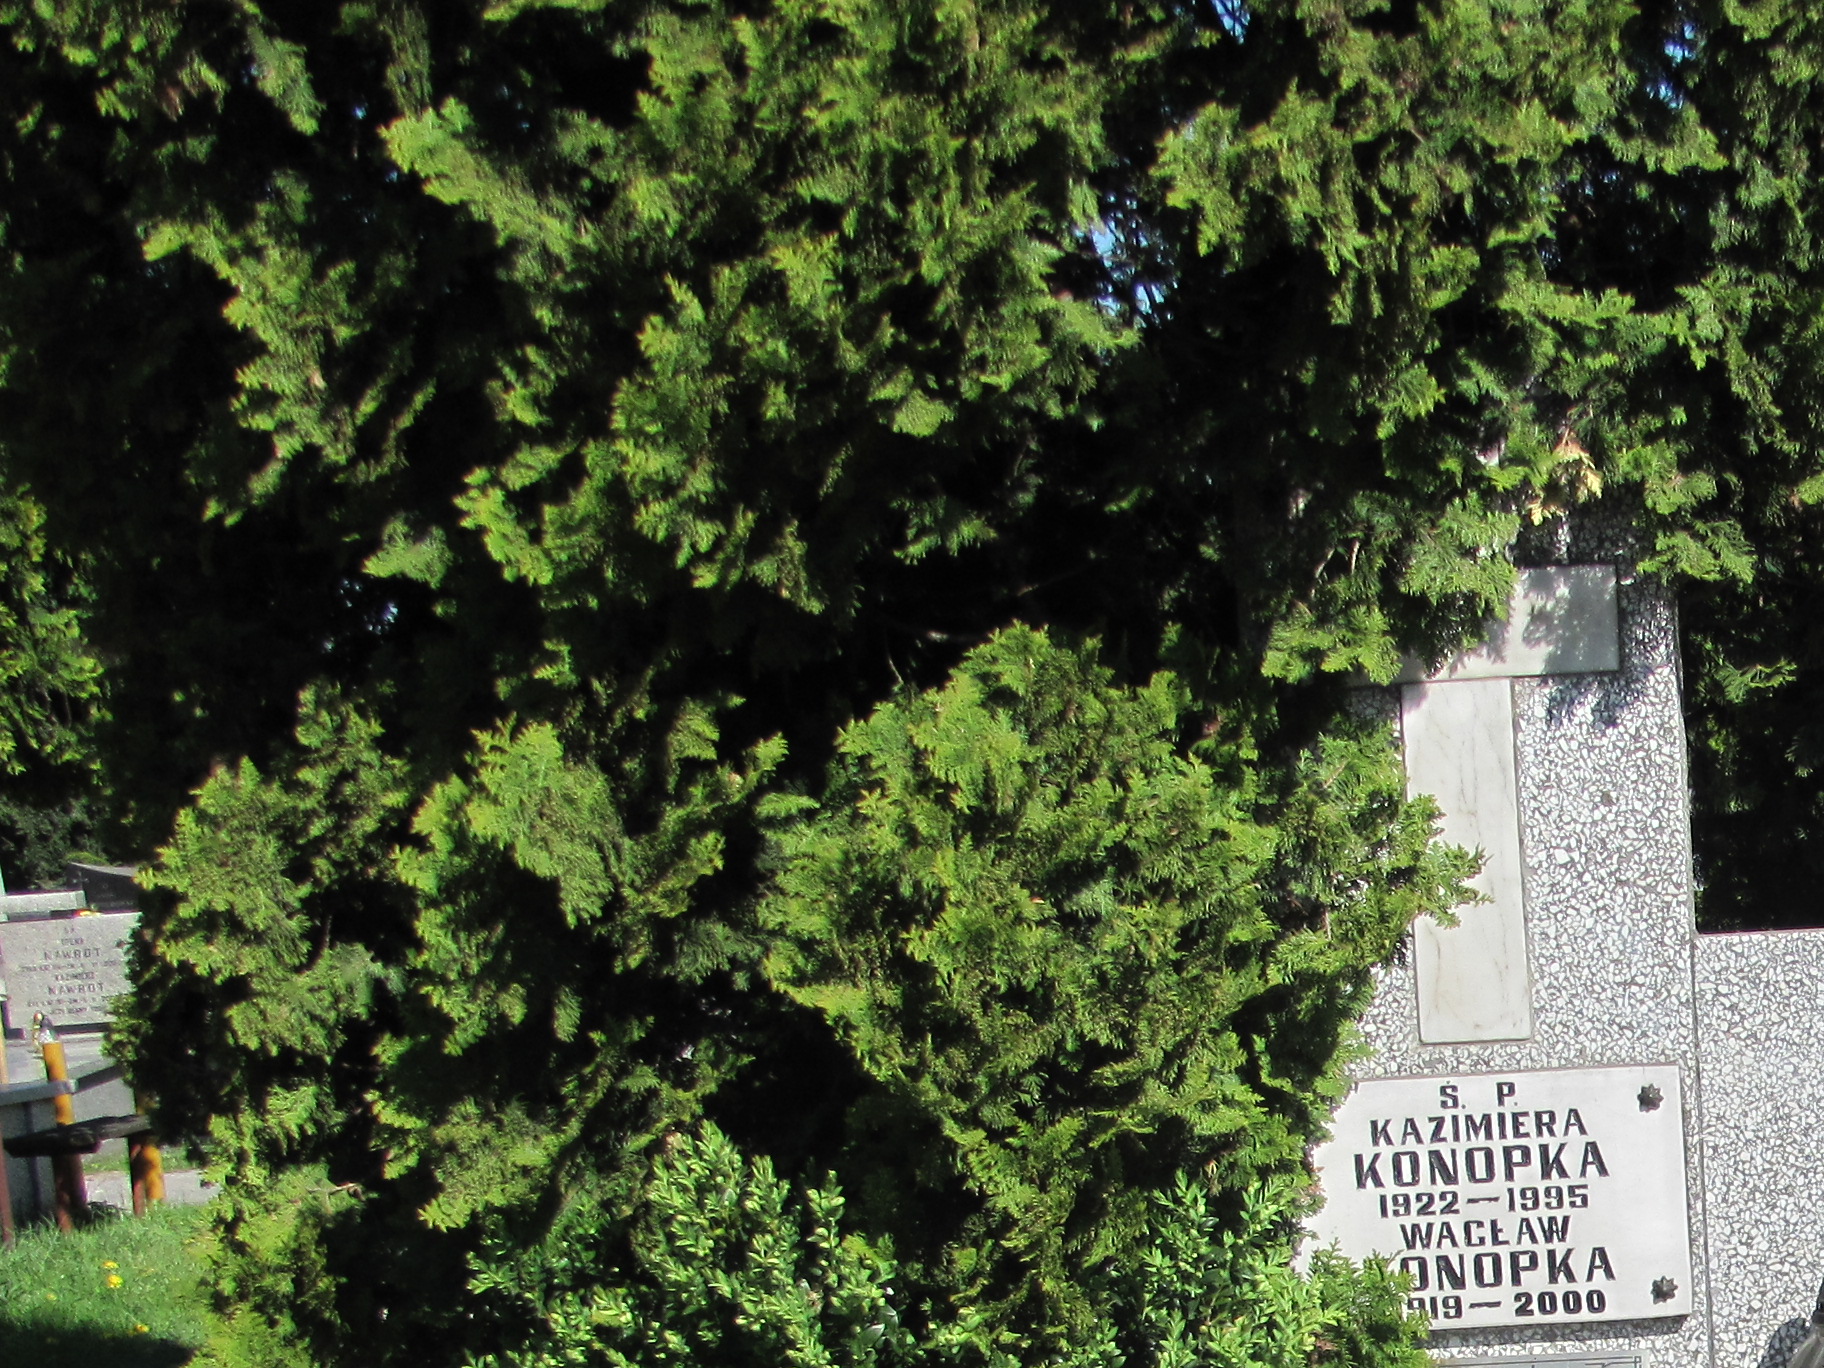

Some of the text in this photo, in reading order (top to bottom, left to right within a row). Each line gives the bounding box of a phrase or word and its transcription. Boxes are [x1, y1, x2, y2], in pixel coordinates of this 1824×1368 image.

[1369, 1108, 1588, 1147] KAZIMIERA
[1353, 1140, 1610, 1189] KONOPKA
[1400, 1215, 1571, 1250] WACŁAW
[1400, 1247, 1616, 1292] ONOPKA
